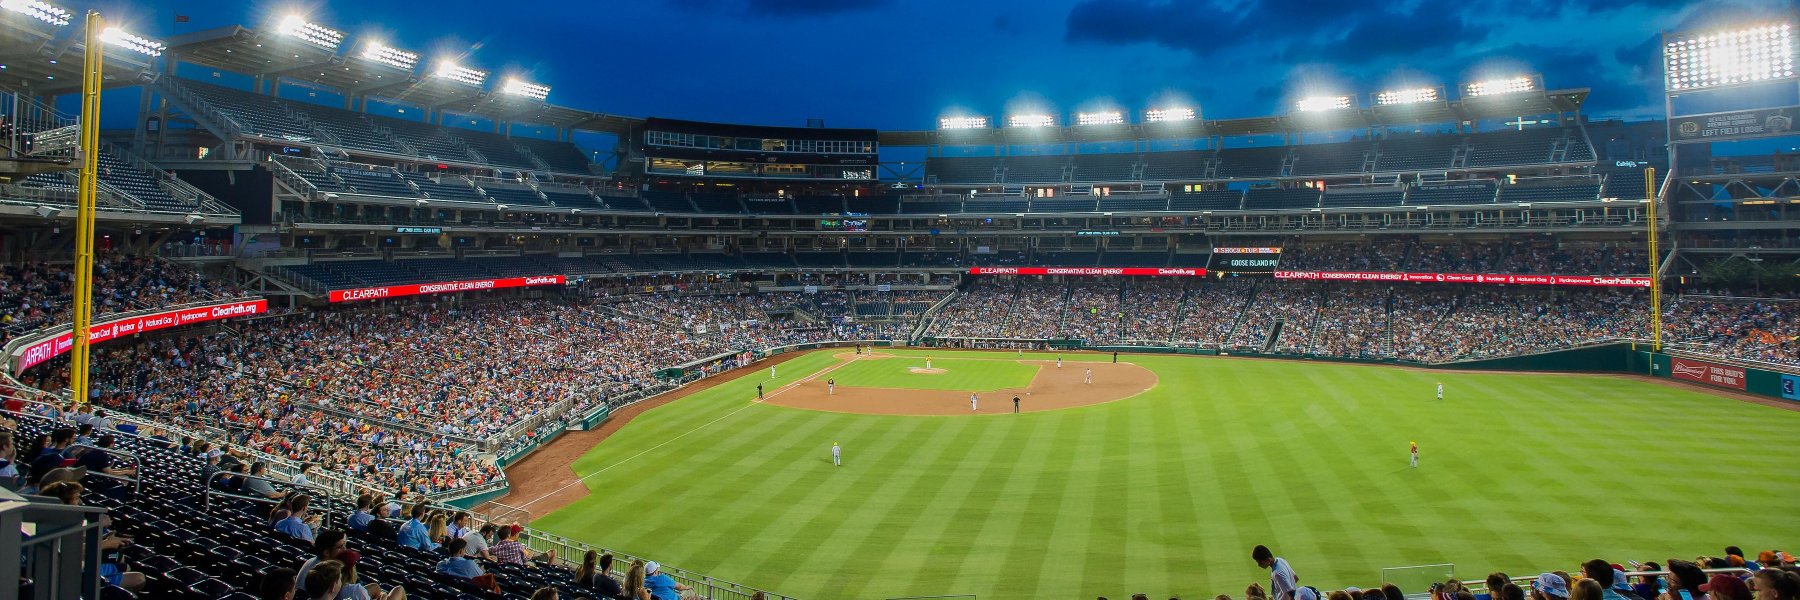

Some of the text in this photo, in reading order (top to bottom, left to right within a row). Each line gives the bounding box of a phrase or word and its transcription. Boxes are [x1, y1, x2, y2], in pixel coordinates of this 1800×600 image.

[1720, 128, 1739, 136] FIELD
[1593, 278, 1650, 286] ClearPath.org
[343, 288, 388, 300] CLEARPATH
[420, 284, 458, 293] CONSERVATIVE
[120, 323, 135, 332] Nuclear
[146, 318, 162, 327] Natural
[182, 311, 208, 321] Hydropower
[212, 304, 256, 317] ClearPath.org
[1710, 367, 1724, 375] THIS
[1725, 369, 1744, 378] BUD'S
[1723, 377, 1738, 385] YOU.
